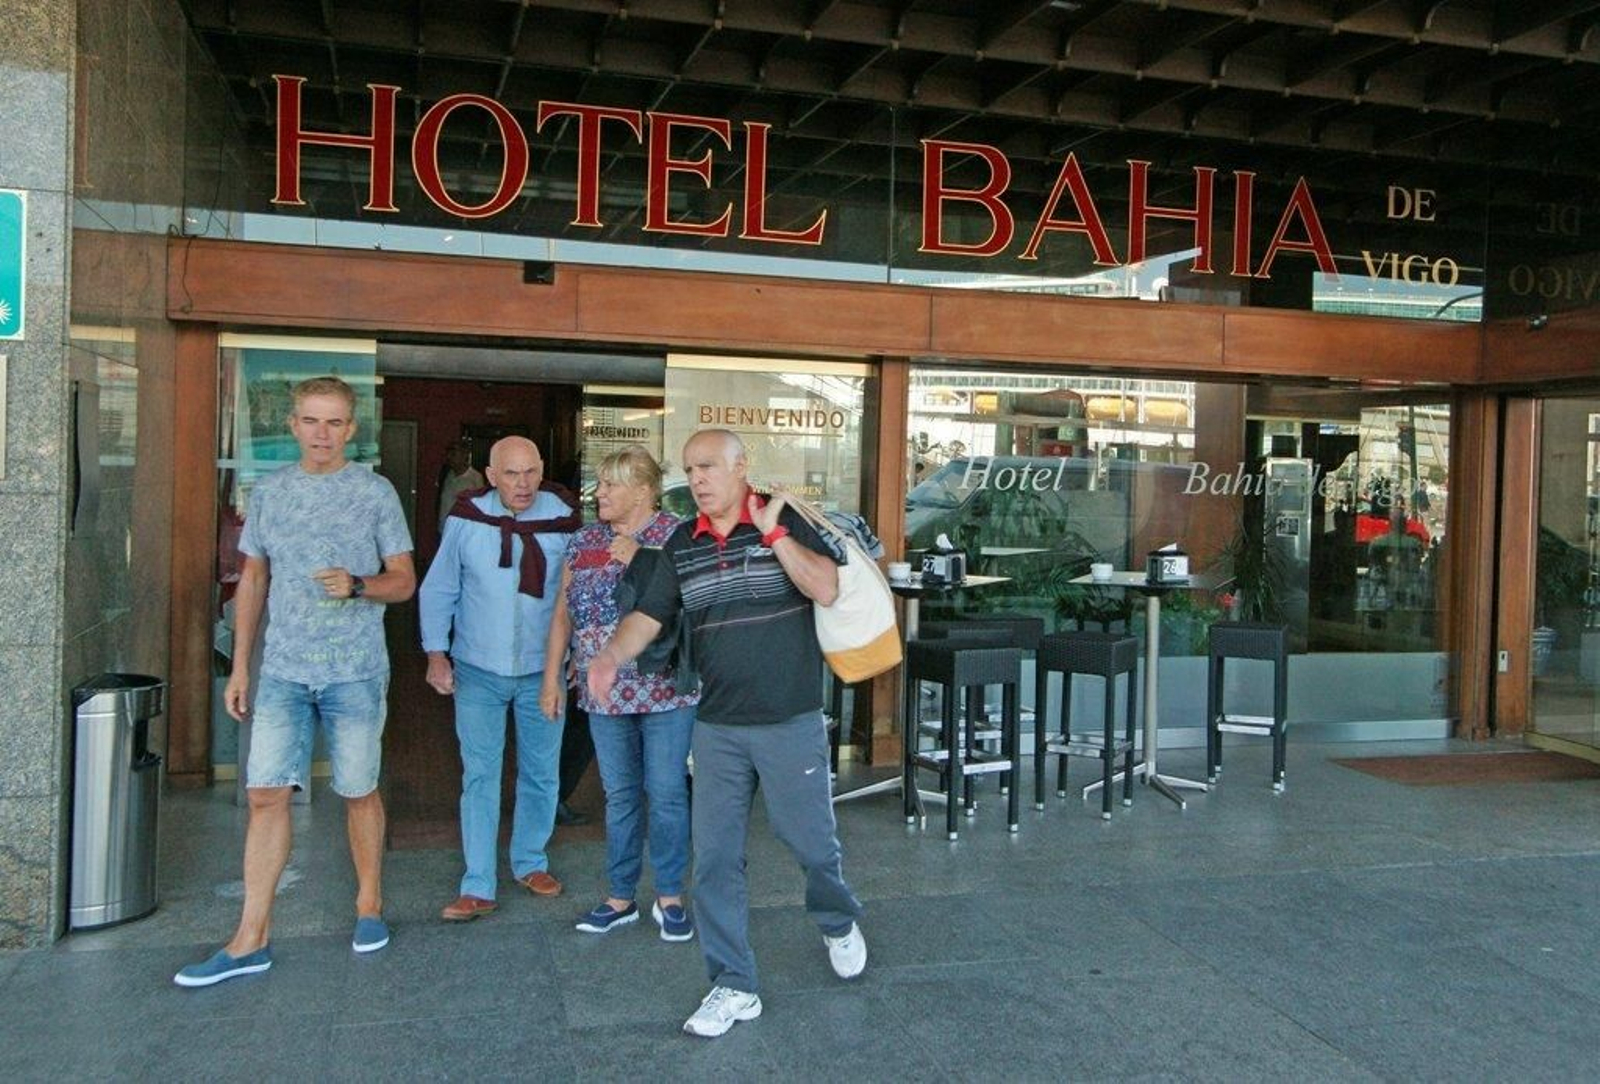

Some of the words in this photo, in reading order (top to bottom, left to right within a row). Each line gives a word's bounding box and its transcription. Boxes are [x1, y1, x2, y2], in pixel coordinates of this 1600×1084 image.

[271, 73, 827, 246] HOTEL
[918, 138, 1340, 283] BAHIA
[1387, 185, 1437, 221] DE
[1361, 250, 1459, 289] VIGO
[699, 405, 845, 429] BIENVENIDO
[957, 455, 1068, 492] Hotel
